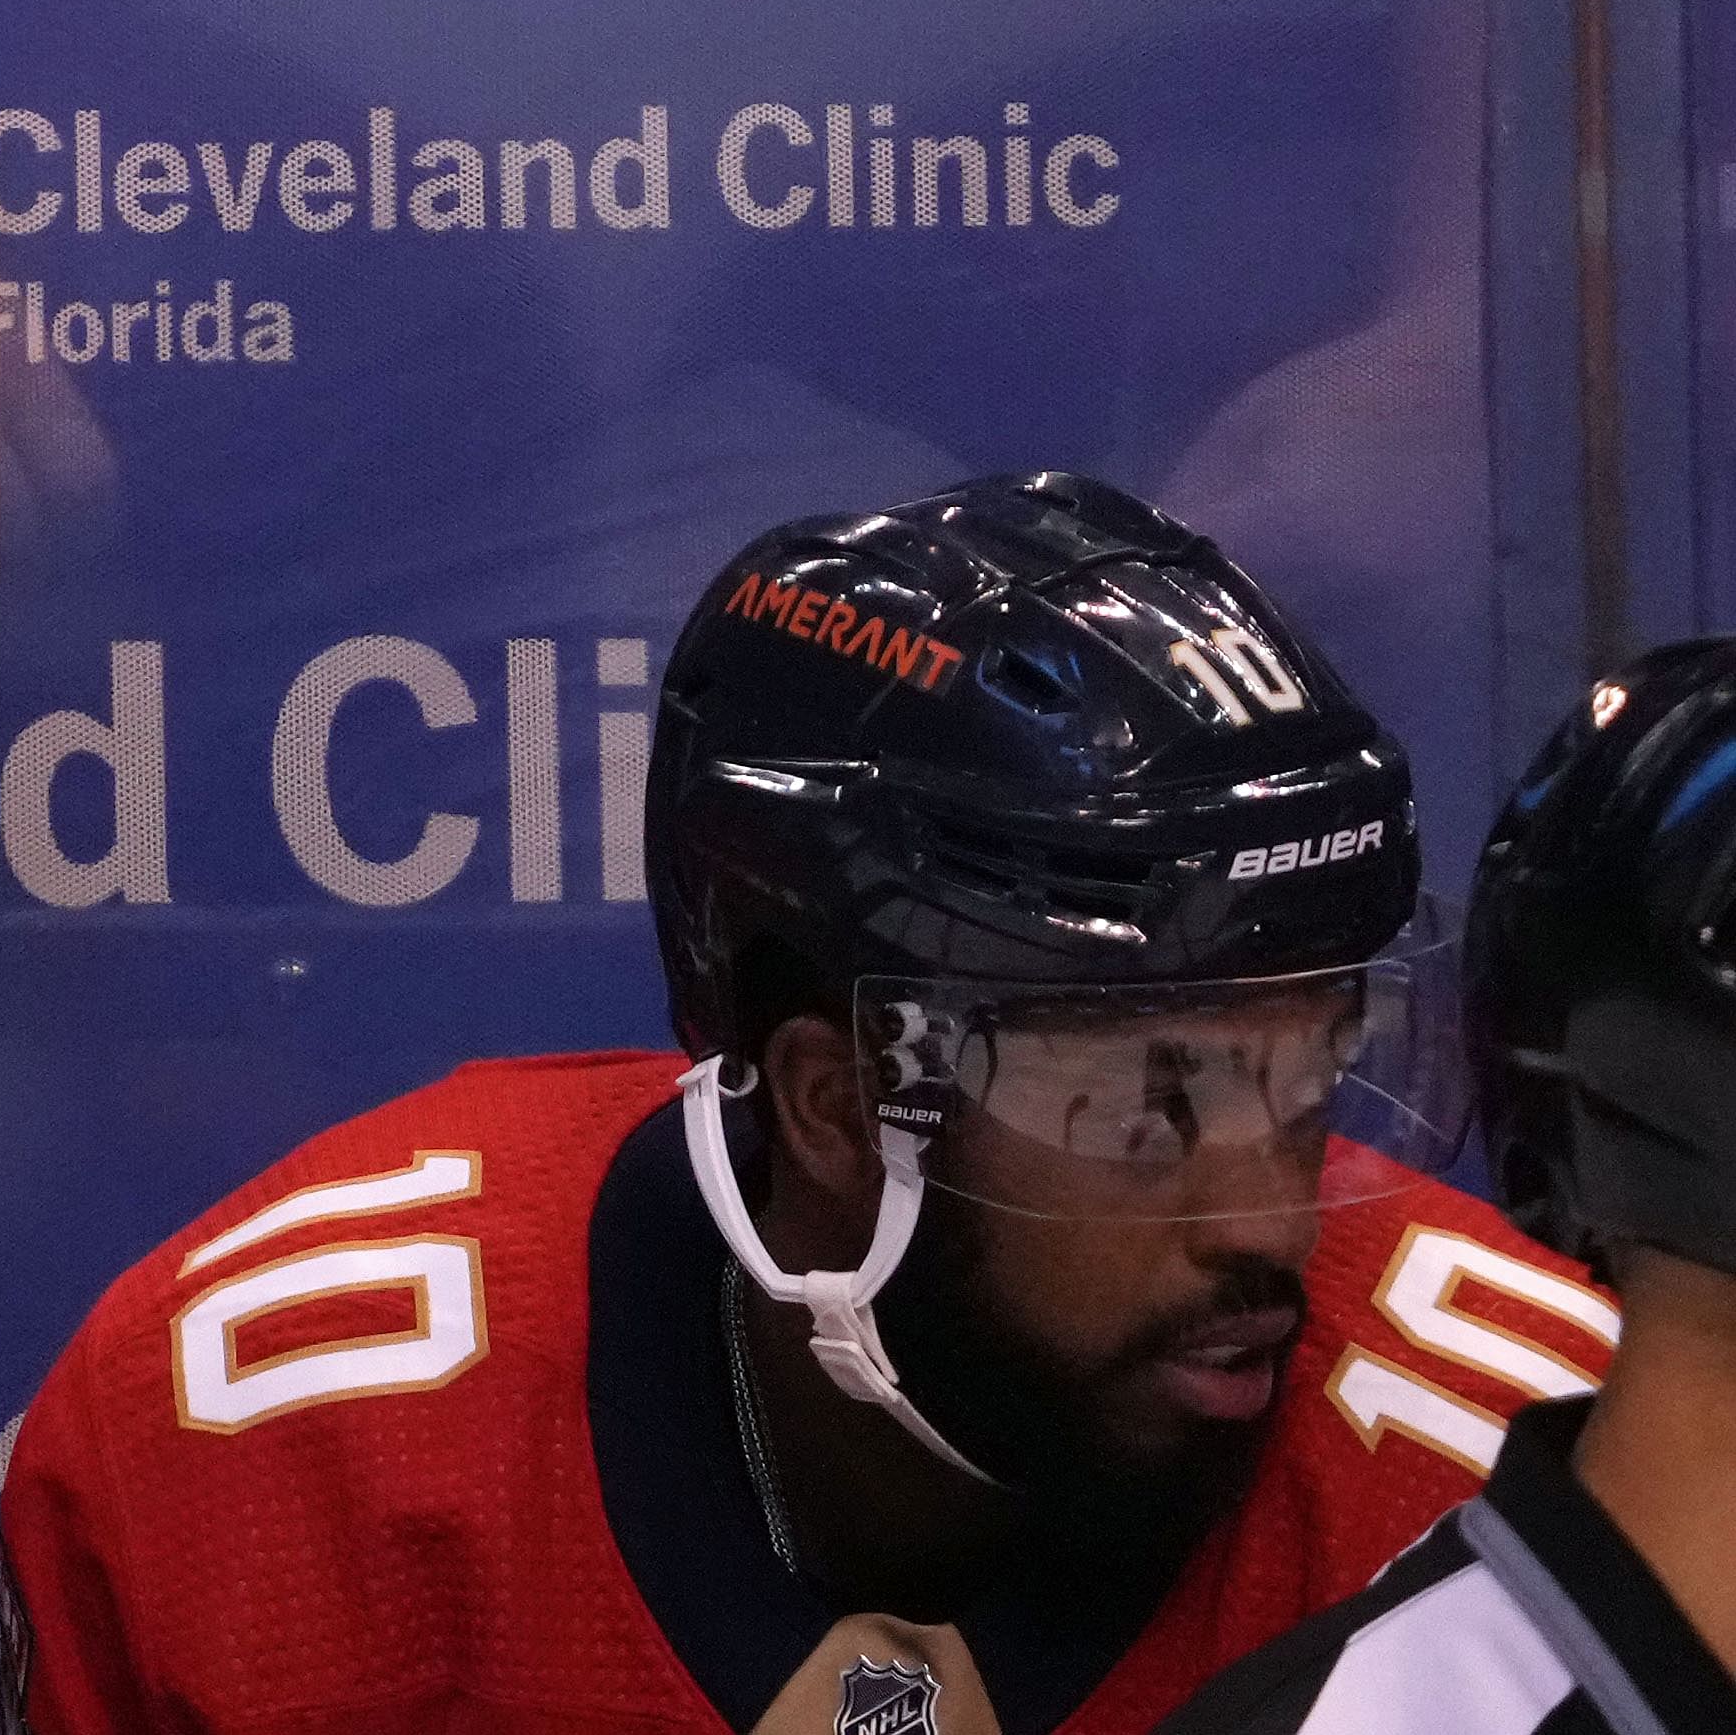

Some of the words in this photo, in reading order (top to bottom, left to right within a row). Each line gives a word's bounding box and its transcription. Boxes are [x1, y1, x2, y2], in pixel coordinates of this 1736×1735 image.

[717, 100, 1122, 230] Clinic
[725, 572, 963, 689] AMERANT
[1169, 626, 1306, 728] 10
[1227, 820, 1384, 880] BAUER
[171, 1150, 490, 1435] 10
[1324, 1223, 1623, 1480] 10
